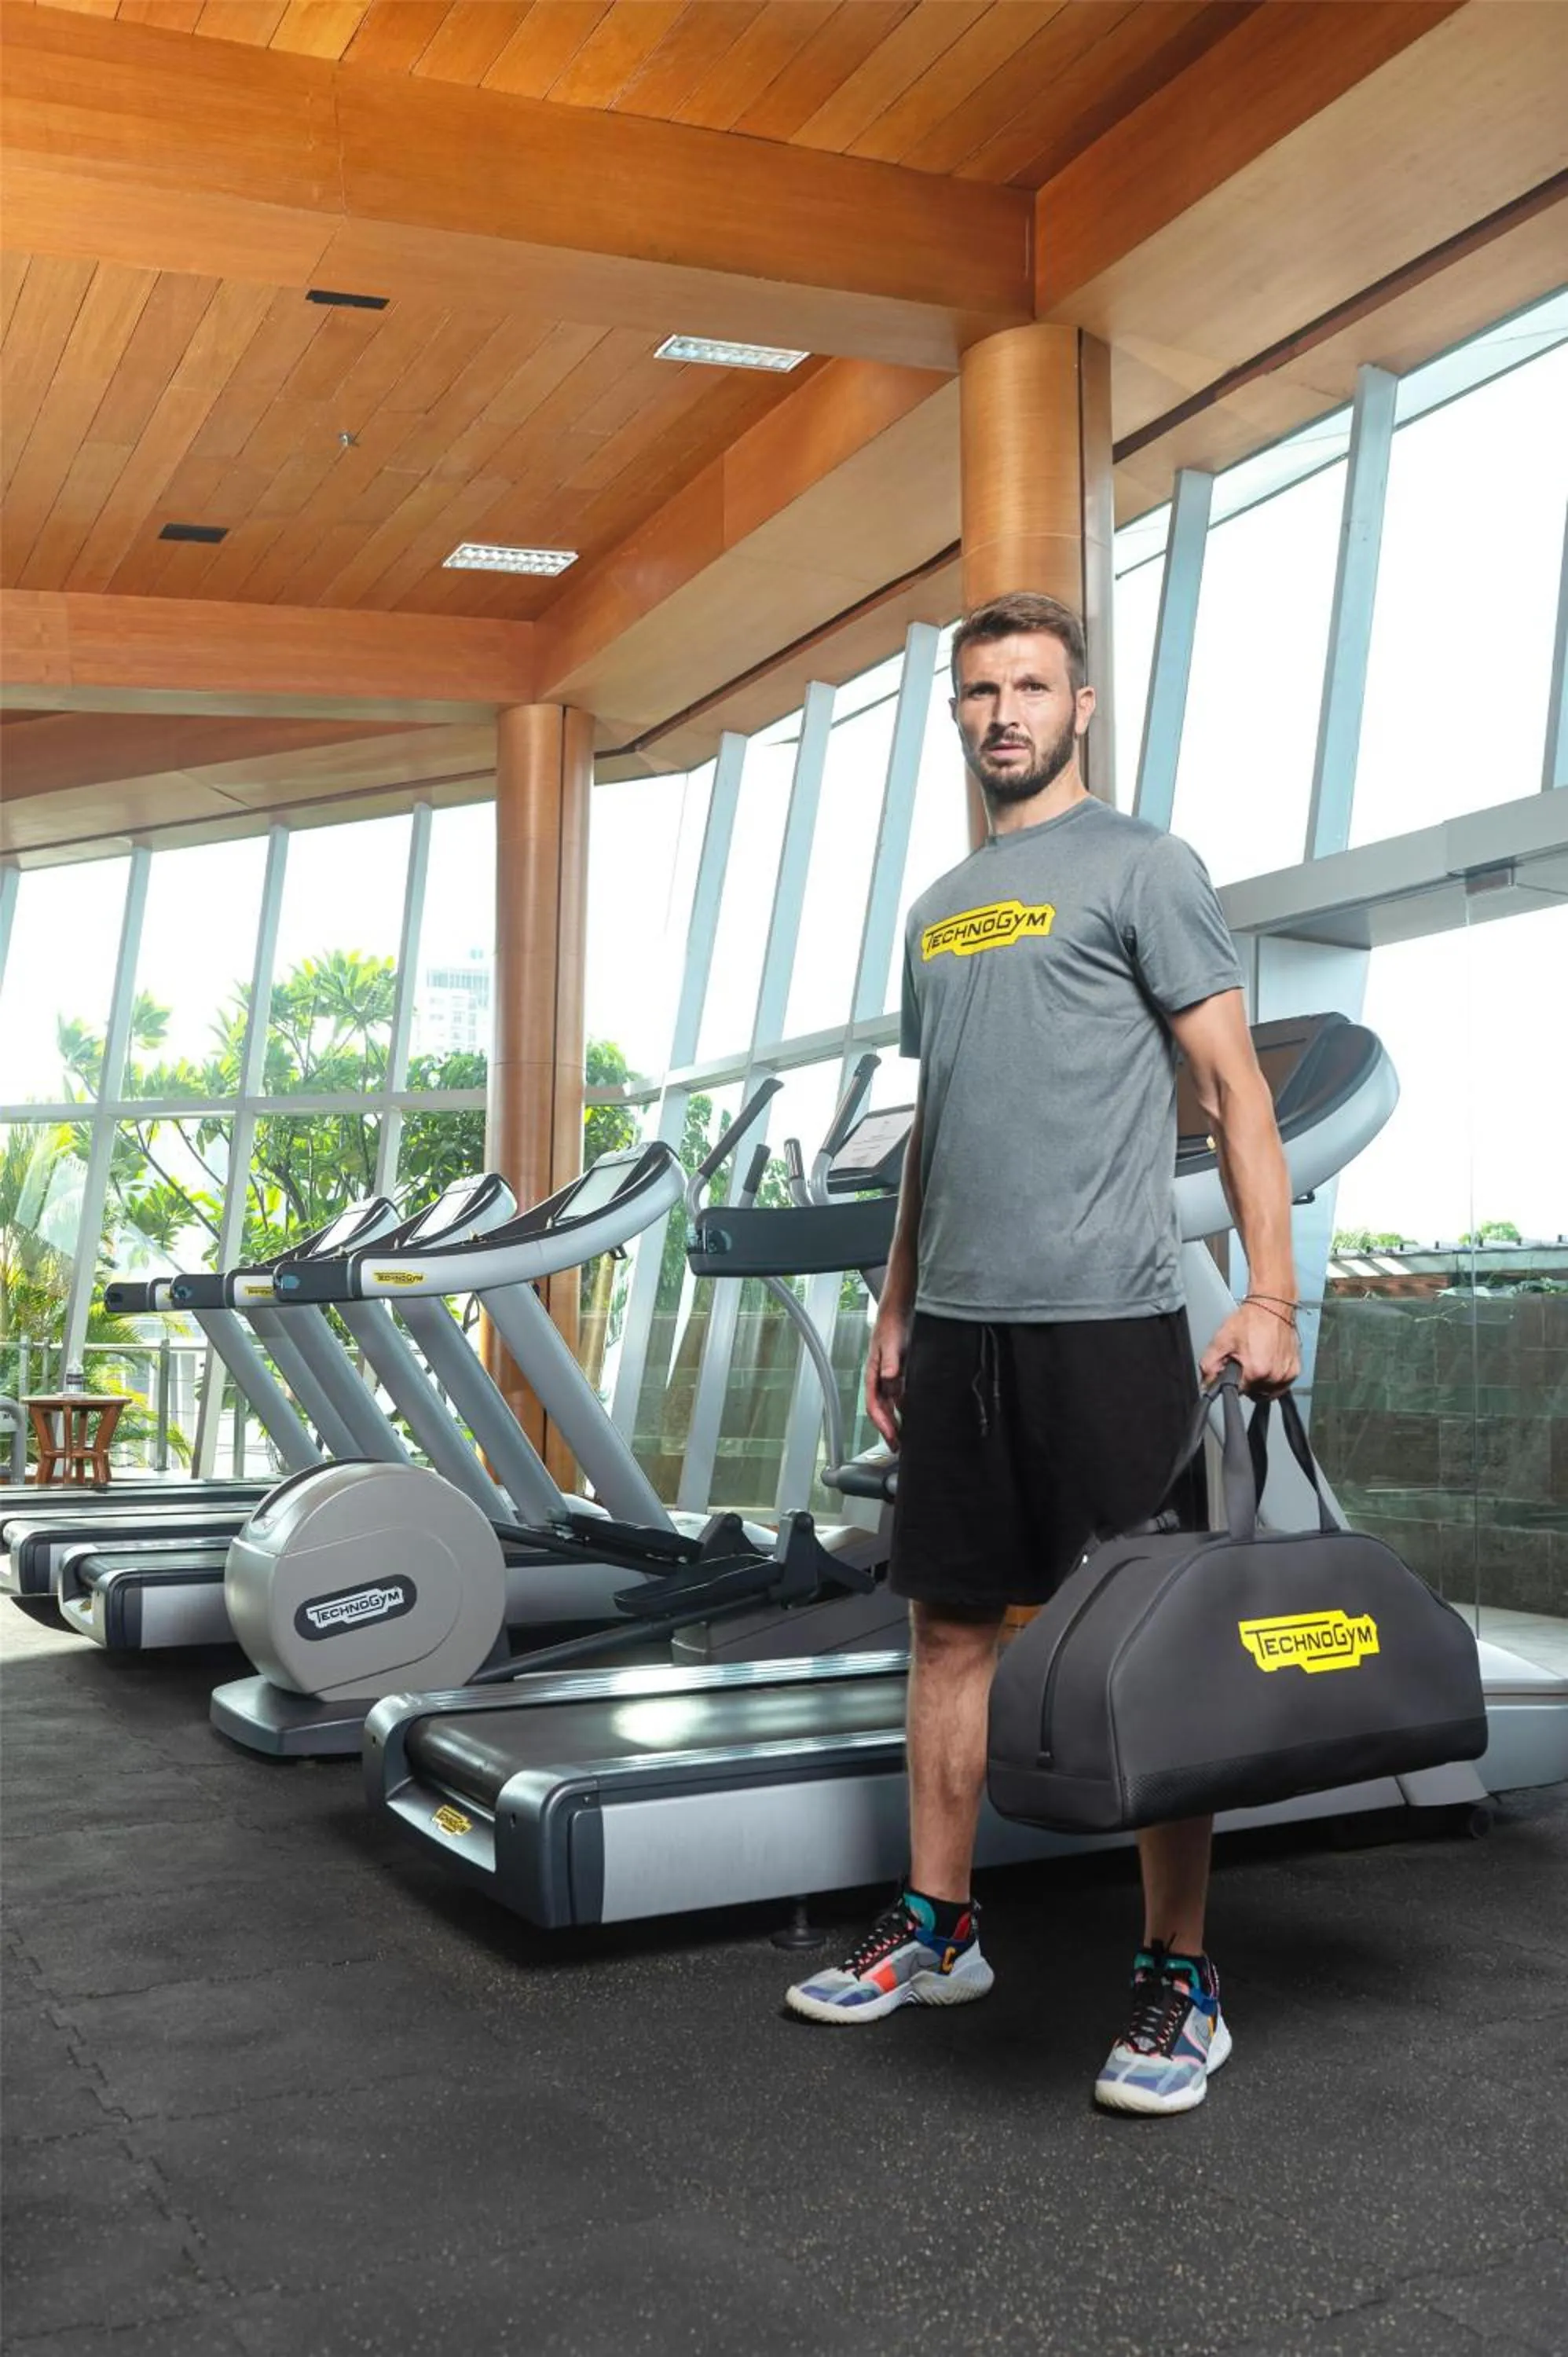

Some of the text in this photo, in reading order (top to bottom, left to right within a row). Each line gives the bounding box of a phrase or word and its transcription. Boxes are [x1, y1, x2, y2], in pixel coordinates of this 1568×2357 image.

[925, 909, 1047, 953] TECHNOGYM
[309, 1591, 400, 1624] TECHNOGYM
[1244, 1620, 1372, 1661] TECHNOGYM
